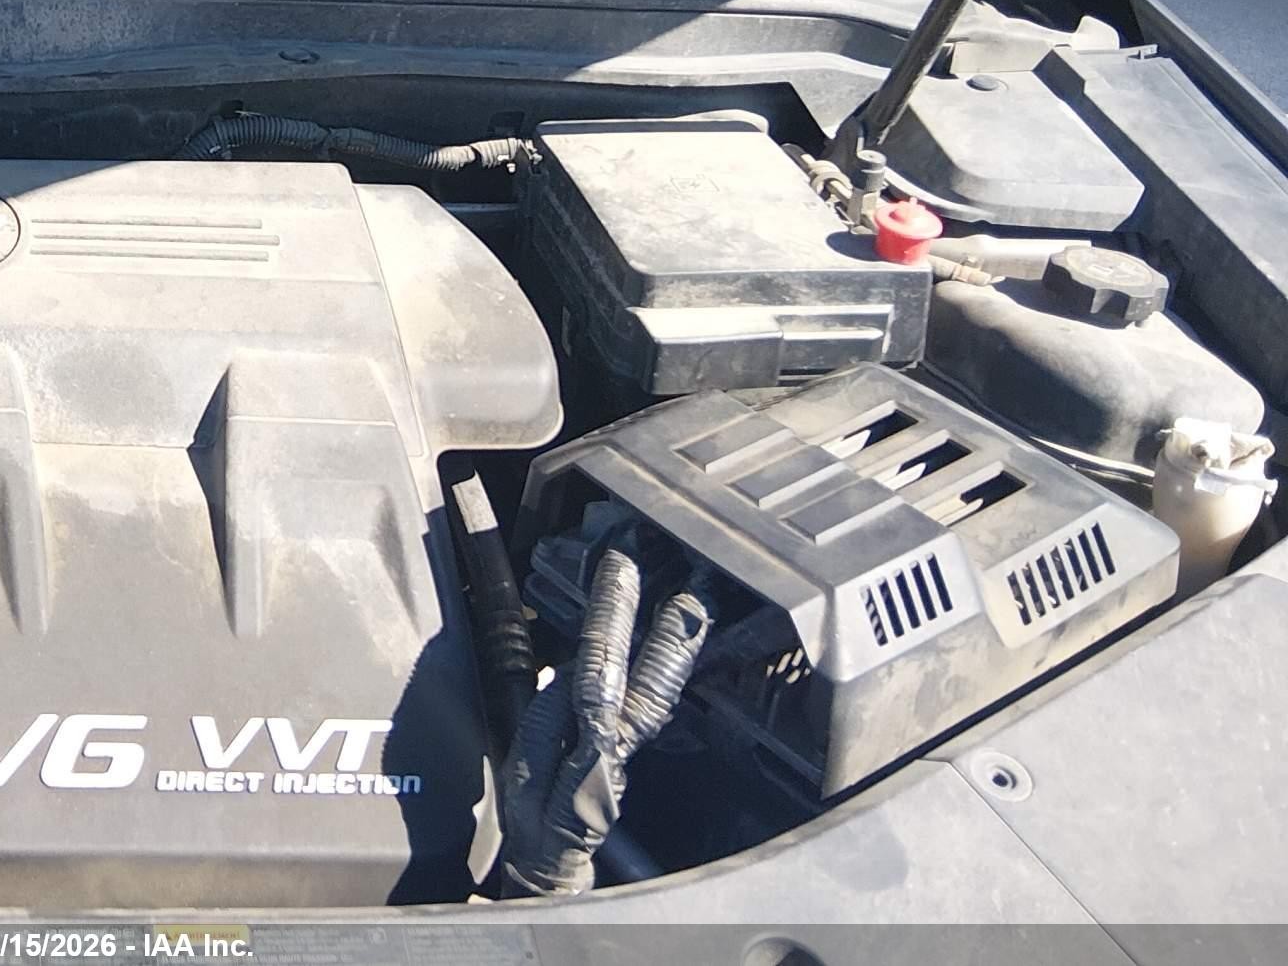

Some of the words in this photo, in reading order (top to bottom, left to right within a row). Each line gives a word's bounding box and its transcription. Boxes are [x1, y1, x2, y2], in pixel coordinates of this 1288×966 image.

[191, 715, 393, 771] VVT
[156, 770, 265, 792] DIRECT
[273, 772, 421, 794] INJECTION
